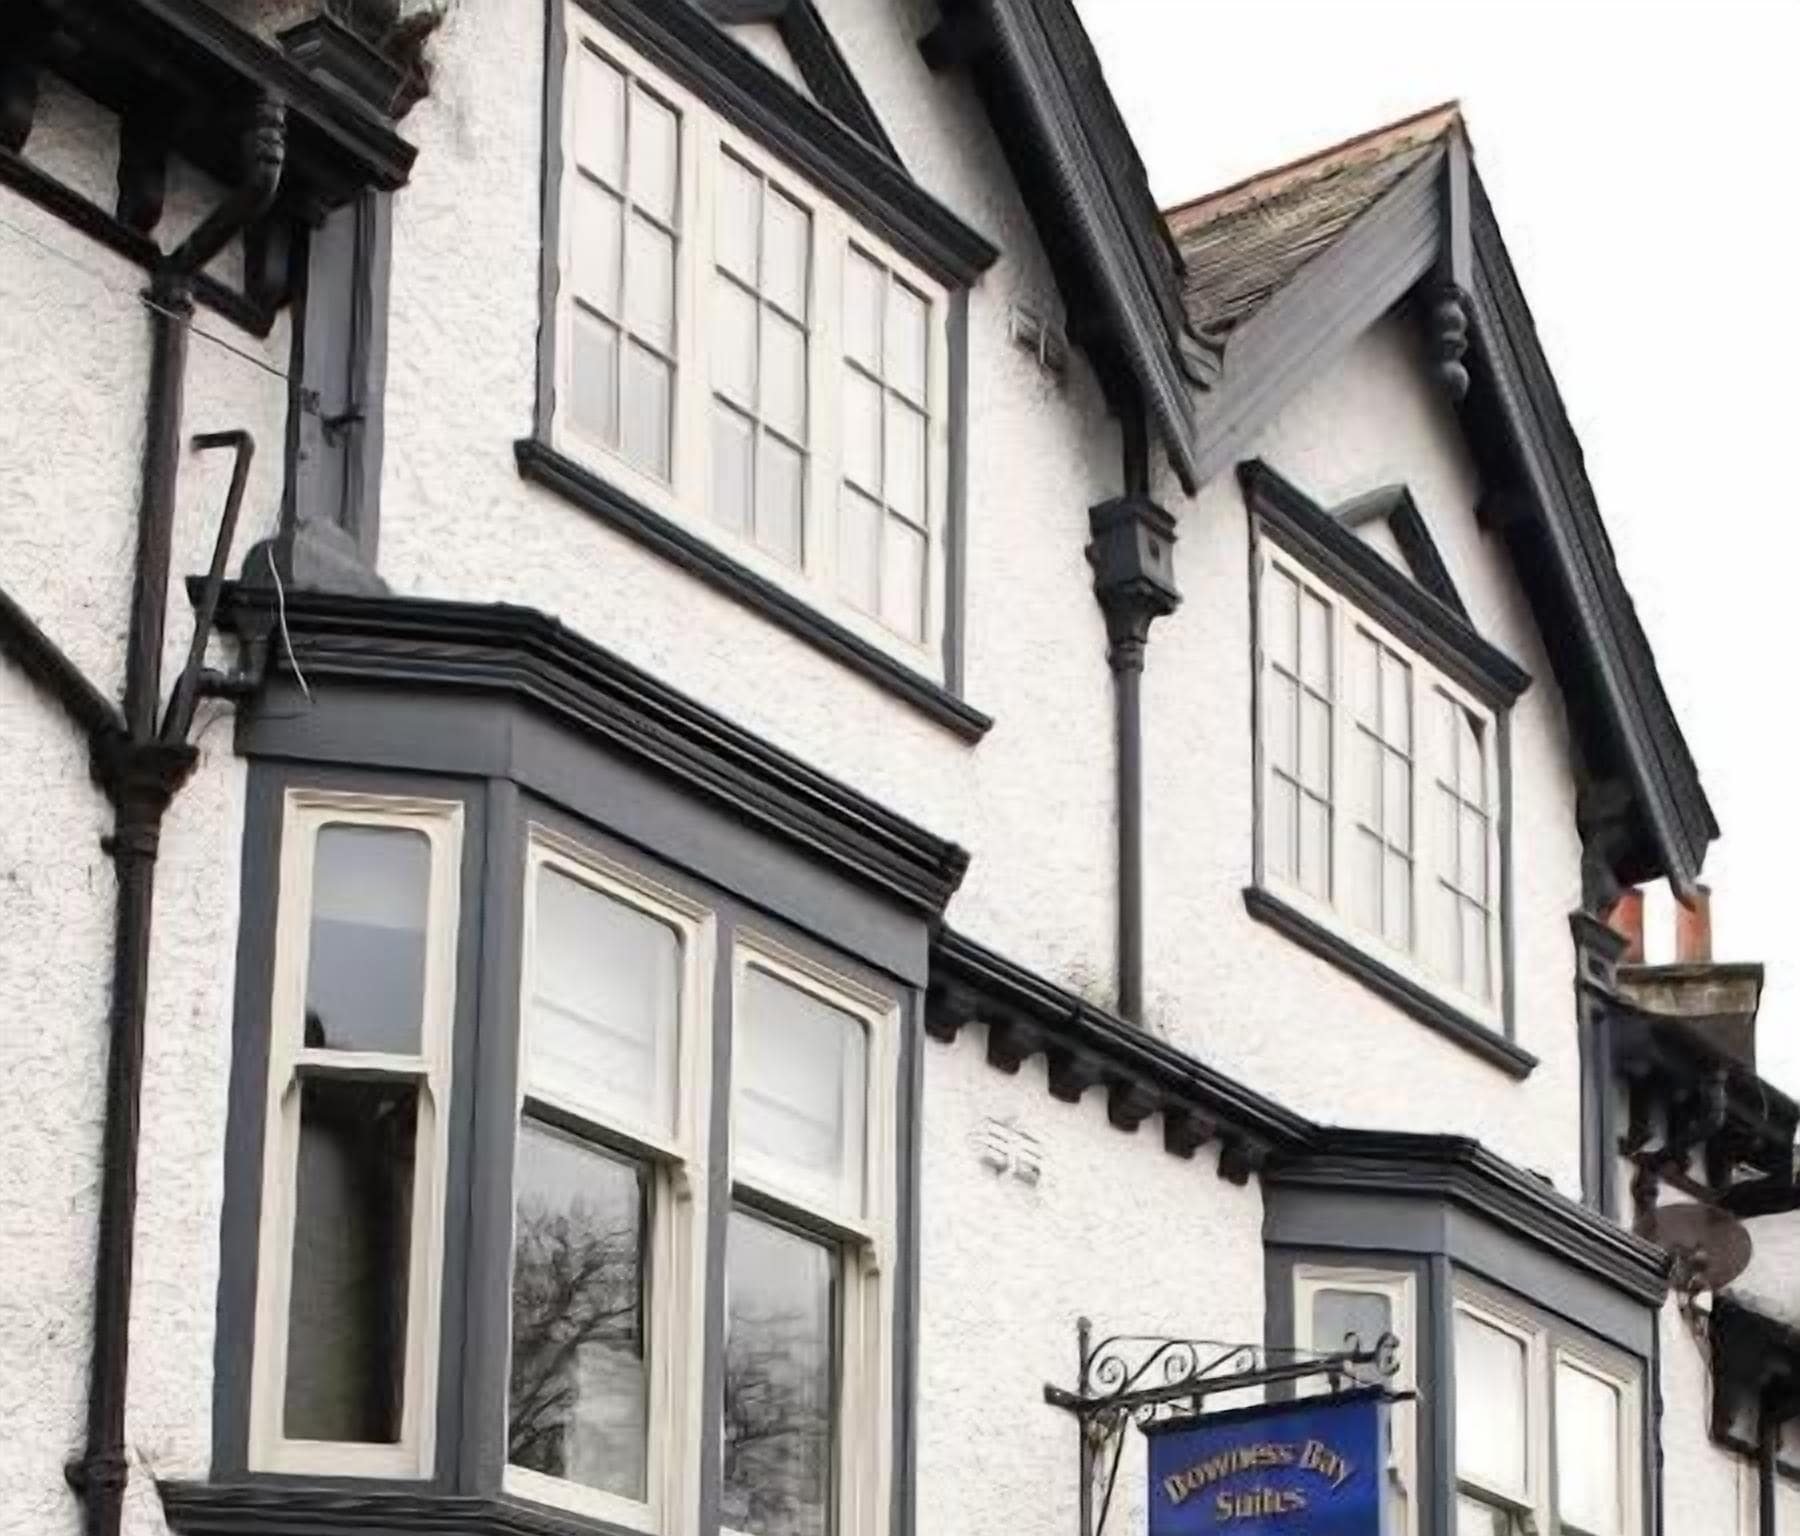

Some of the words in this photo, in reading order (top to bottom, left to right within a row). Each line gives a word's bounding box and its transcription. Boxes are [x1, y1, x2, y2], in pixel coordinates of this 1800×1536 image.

[1163, 1444, 1296, 1504] Bowness
[1301, 1439, 1354, 1489] Bay
[1215, 1488, 1307, 1521] Suites
